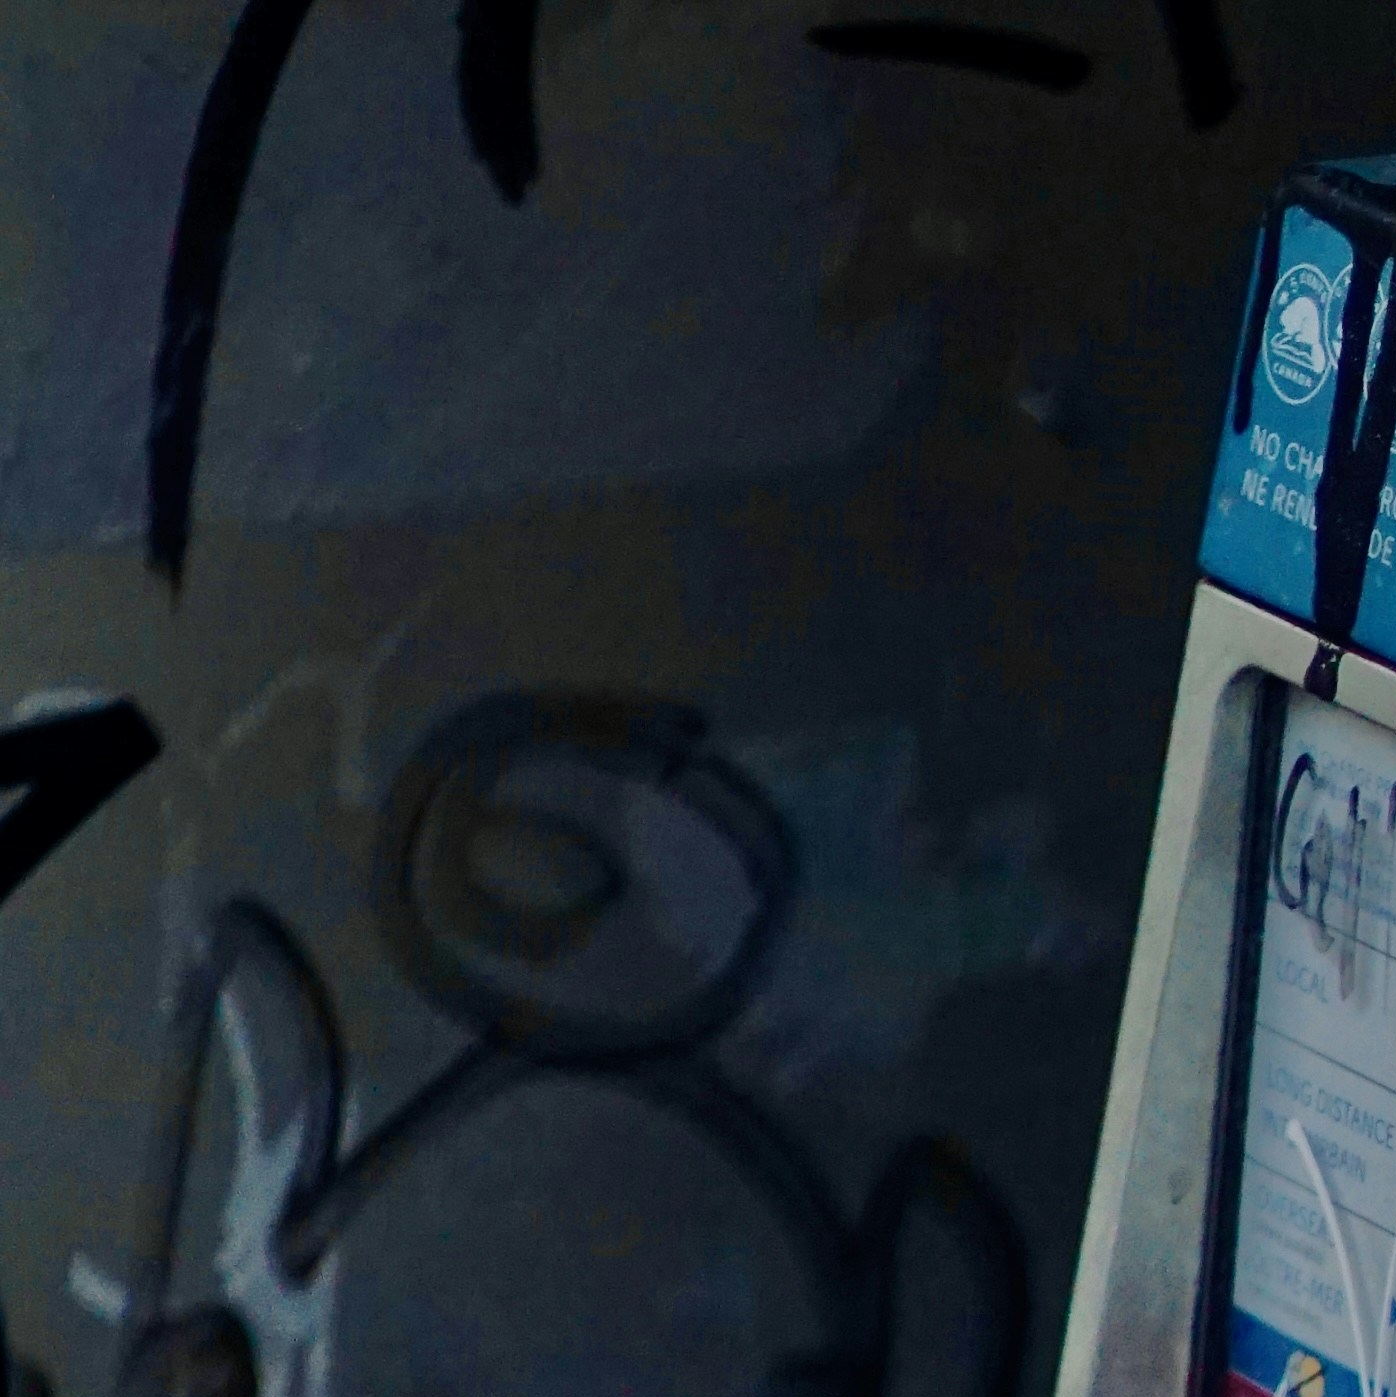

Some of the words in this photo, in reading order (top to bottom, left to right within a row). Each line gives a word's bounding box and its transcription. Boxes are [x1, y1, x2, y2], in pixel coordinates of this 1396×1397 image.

[1247, 423, 1282, 464] NO
[1238, 466, 1270, 507] NE
[1366, 527, 1396, 568] DE
[1314, 1085, 1396, 1151] DISTANCE
